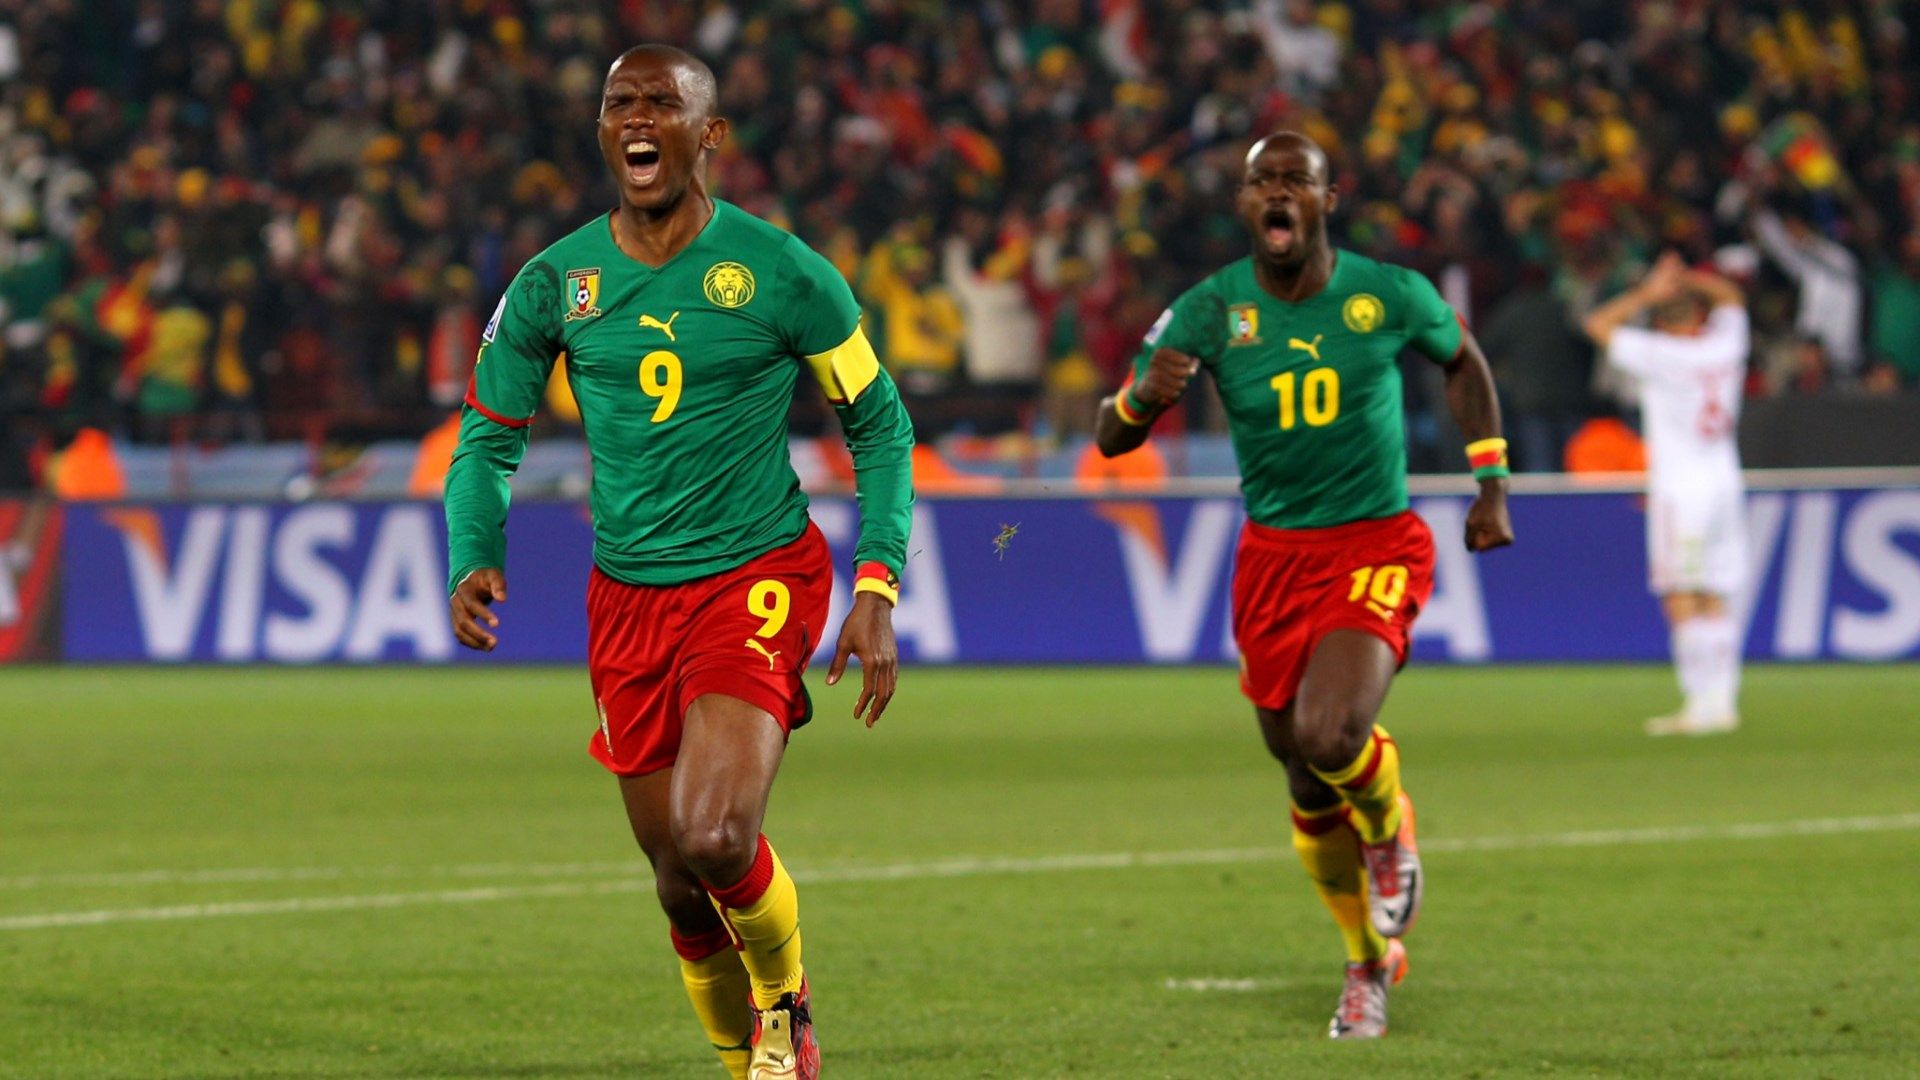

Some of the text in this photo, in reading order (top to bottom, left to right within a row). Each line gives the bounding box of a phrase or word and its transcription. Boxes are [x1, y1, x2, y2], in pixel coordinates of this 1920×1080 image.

[639, 350, 683, 423] 9
[1270, 367, 1340, 431] 10
[102, 507, 456, 660] VISA
[747, 580, 790, 639] 9
[1094, 501, 1492, 659] VA
[1347, 565, 1409, 608] 10
